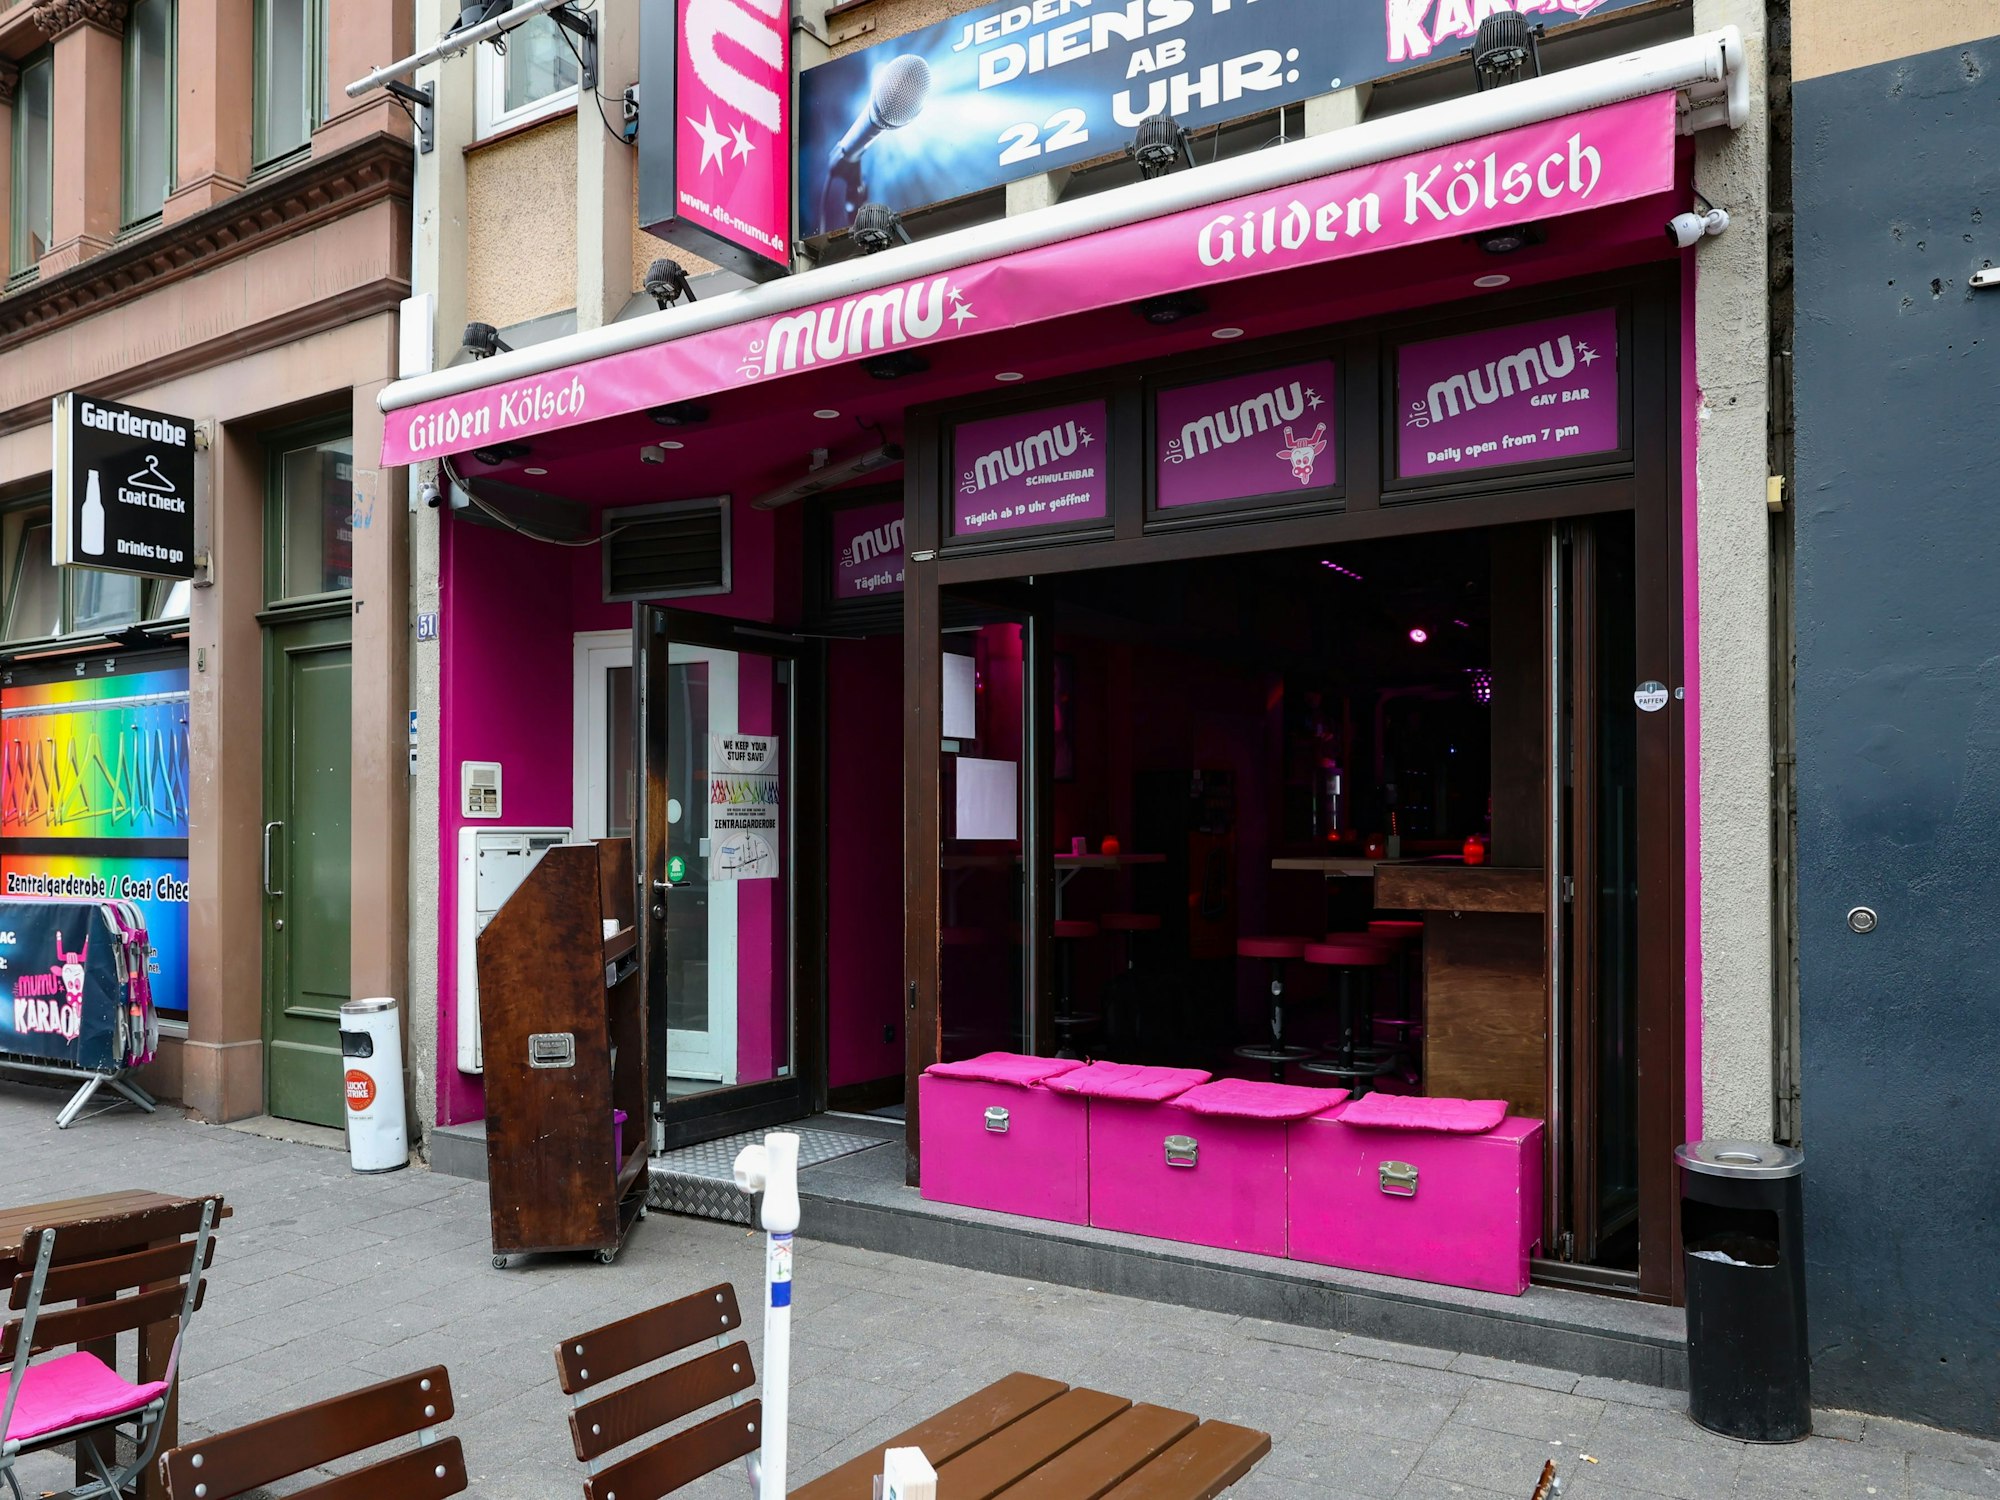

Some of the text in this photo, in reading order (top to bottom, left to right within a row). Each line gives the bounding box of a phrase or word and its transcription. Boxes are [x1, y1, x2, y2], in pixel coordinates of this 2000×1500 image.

[1126, 38, 1186, 80] AB
[997, 47, 1300, 167] 22 UHR:
[1198, 131, 1602, 267] Gilden Kölsch
[680, 190, 784, 252] www.die-mumu.de
[736, 339, 764, 380] die
[1530, 388, 1590, 407] GAY BAR
[81, 401, 187, 447] Garderobe
[408, 375, 585, 452] Gilden Kölsch
[1406, 400, 1430, 428] die
[1163, 438, 1183, 464] die
[1427, 424, 1579, 464] Daily open from 7 pm
[960, 470, 977, 494] die
[1026, 468, 1094, 486] SCHWULENBAR
[118, 487, 186, 513] Coat Check
[965, 492, 1090, 527] Täglich ab 19 Uhr geöffnet
[117, 539, 184, 564] Drinks to go
[855, 571, 893, 592] Täglich
[419, 615, 434, 637] 51
[1638, 697, 1664, 705] PAFFEN
[723, 740, 767, 752] WE KEEP YOUR
[727, 752, 765, 762] STUFF SAVE!
[715, 819, 776, 829] ZENTRALGARDEROBE
[7, 874, 105, 897] Zentralgarderobe
[110, 877, 117, 896] /
[121, 876, 152, 899] Coat
[346, 1081, 368, 1090] LUCKY
[346, 1089, 369, 1099] STRIKE
